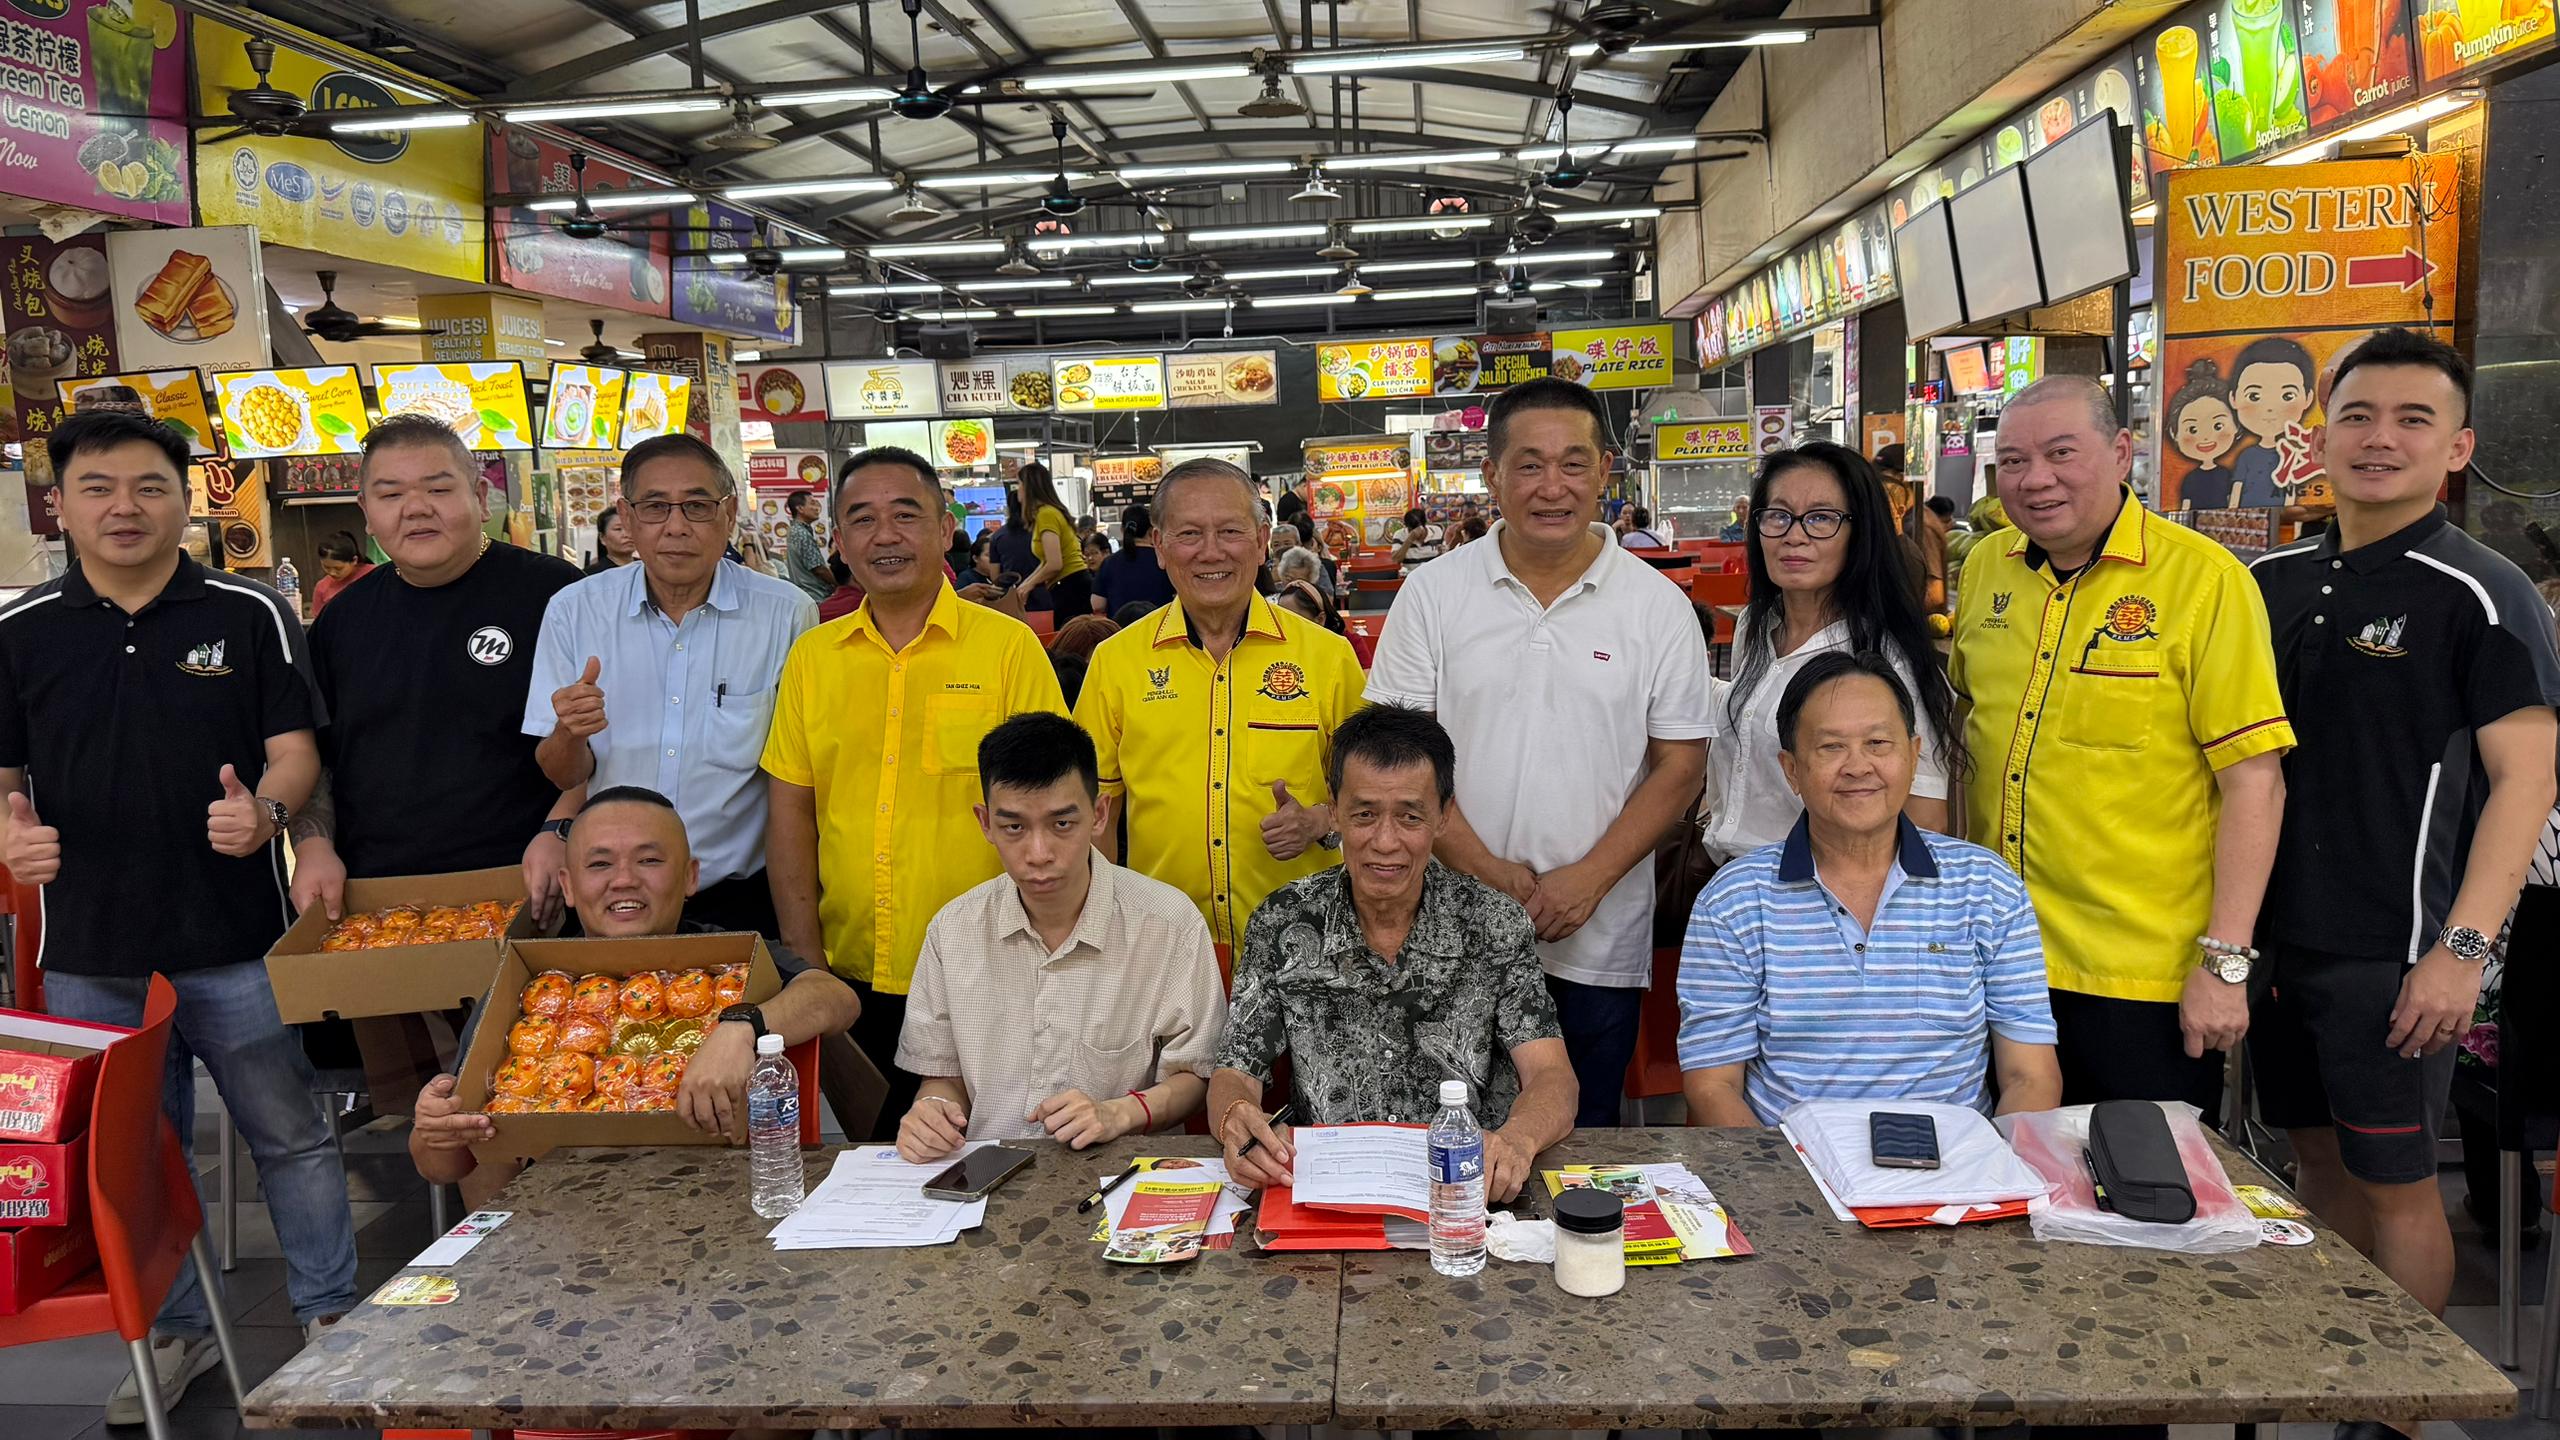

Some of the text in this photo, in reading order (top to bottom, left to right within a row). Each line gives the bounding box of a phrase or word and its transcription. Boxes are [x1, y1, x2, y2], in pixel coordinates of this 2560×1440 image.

[2454, 16, 2538, 61] Pumpkin juice
[0, 66, 83, 106] reen Tea
[2354, 75, 2411, 107] Carrot juice
[6, 97, 68, 137] Lemon
[2256, 126, 2281, 148] Apple
[2186, 182, 2438, 239] WESTERN
[20, 245, 46, 317] 叉烧包
[2183, 251, 2336, 303] FOOD
[499, 315, 541, 339] JUICES!
[432, 338, 472, 348] HEALTHY
[1586, 336, 1661, 359] 碟仔饭
[435, 350, 482, 360] DELICIOUS
[1494, 354, 1531, 370] SPECIAL
[1582, 358, 1665, 374] PLATE RICE
[951, 370, 996, 390] 炒粿
[1479, 368, 1548, 385] SALAD CHICKEN
[155, 391, 188, 404] Classic
[331, 387, 353, 399] Corn
[946, 391, 1002, 403] CHA KUEH
[1685, 428, 1743, 444] 碟仔饭
[476, 451, 500, 461] Fruit
[1674, 443, 1751, 456] PLATE RICE
